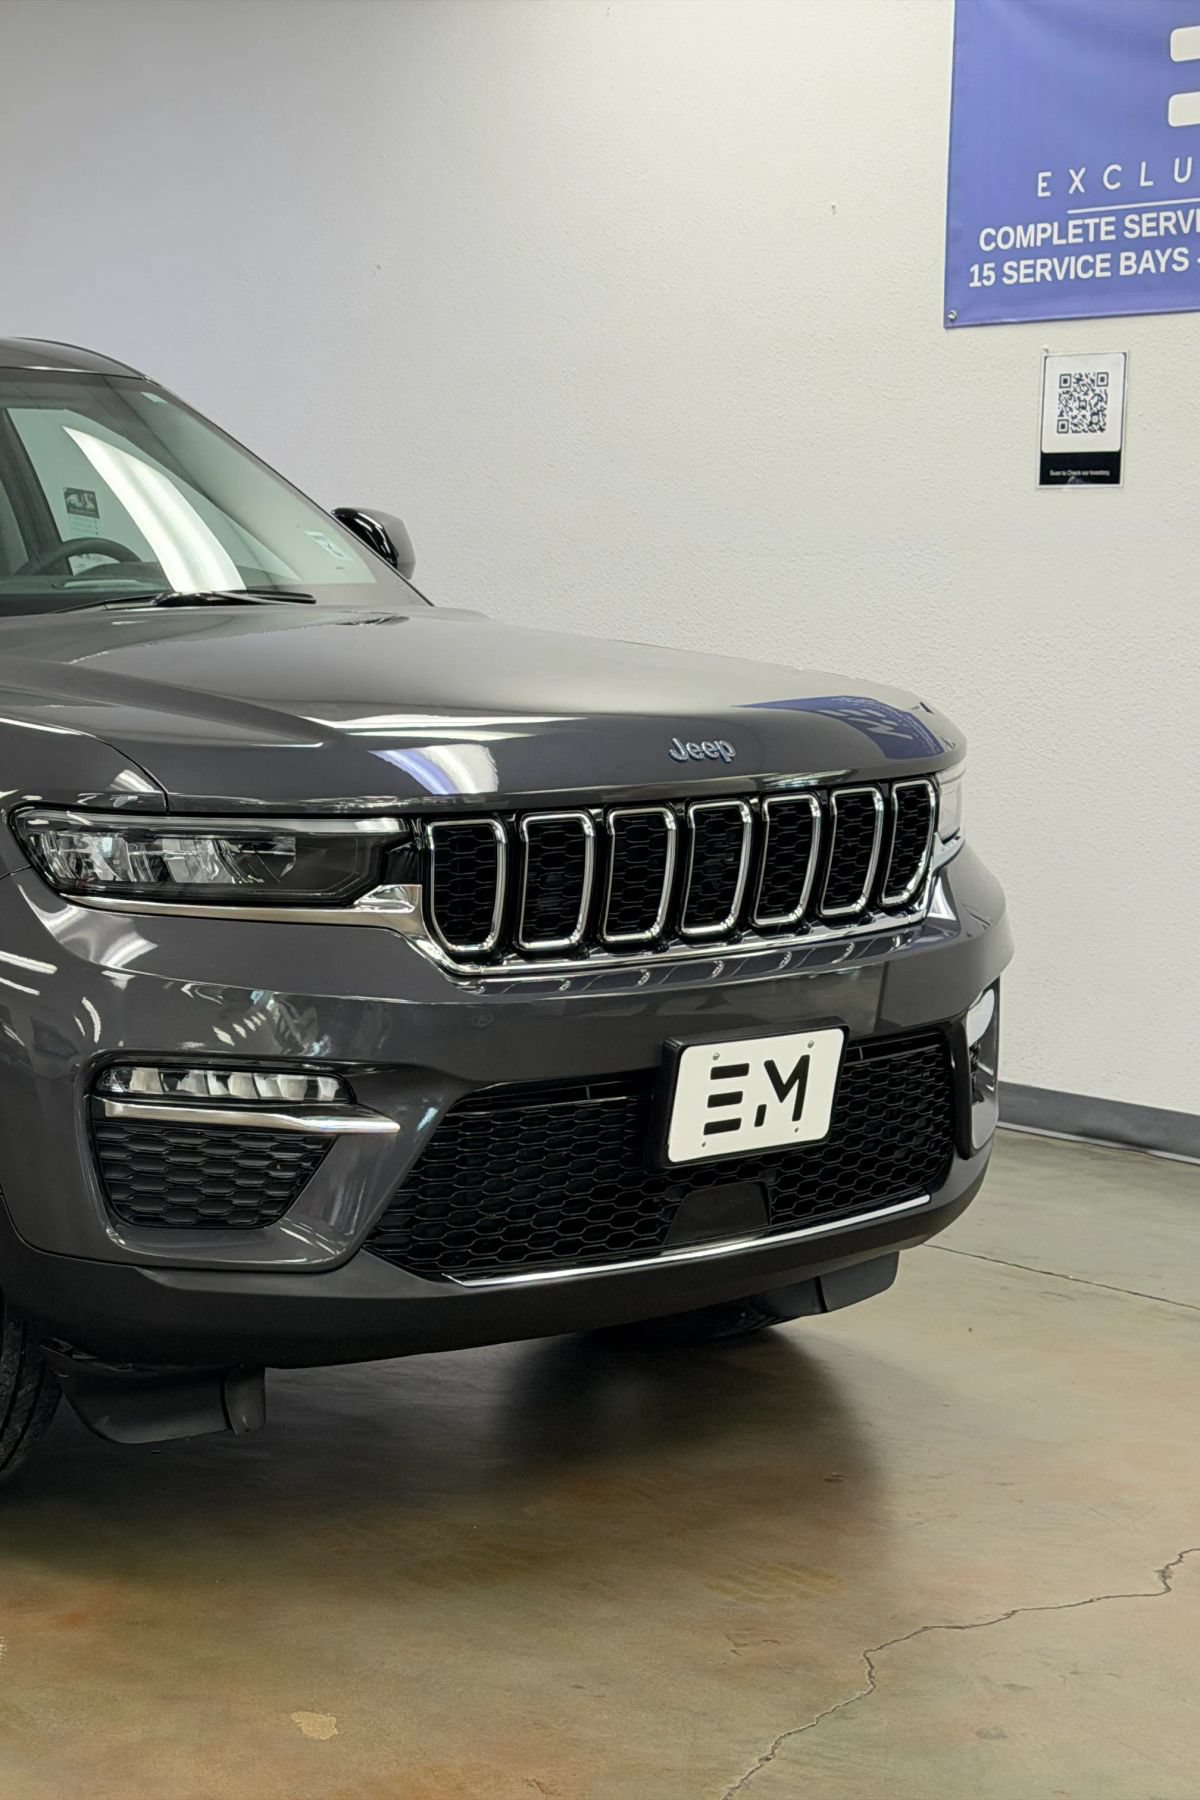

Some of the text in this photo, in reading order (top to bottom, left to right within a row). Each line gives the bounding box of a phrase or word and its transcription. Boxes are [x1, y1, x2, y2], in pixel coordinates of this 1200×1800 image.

[1037, 157, 1192, 197] EXCLU
[979, 216, 1116, 251] COMPLETE
[969, 247, 1190, 287] 15 SERVICE BAYS
[668, 737, 736, 762] Jeep
[703, 1054, 811, 1136] EM
